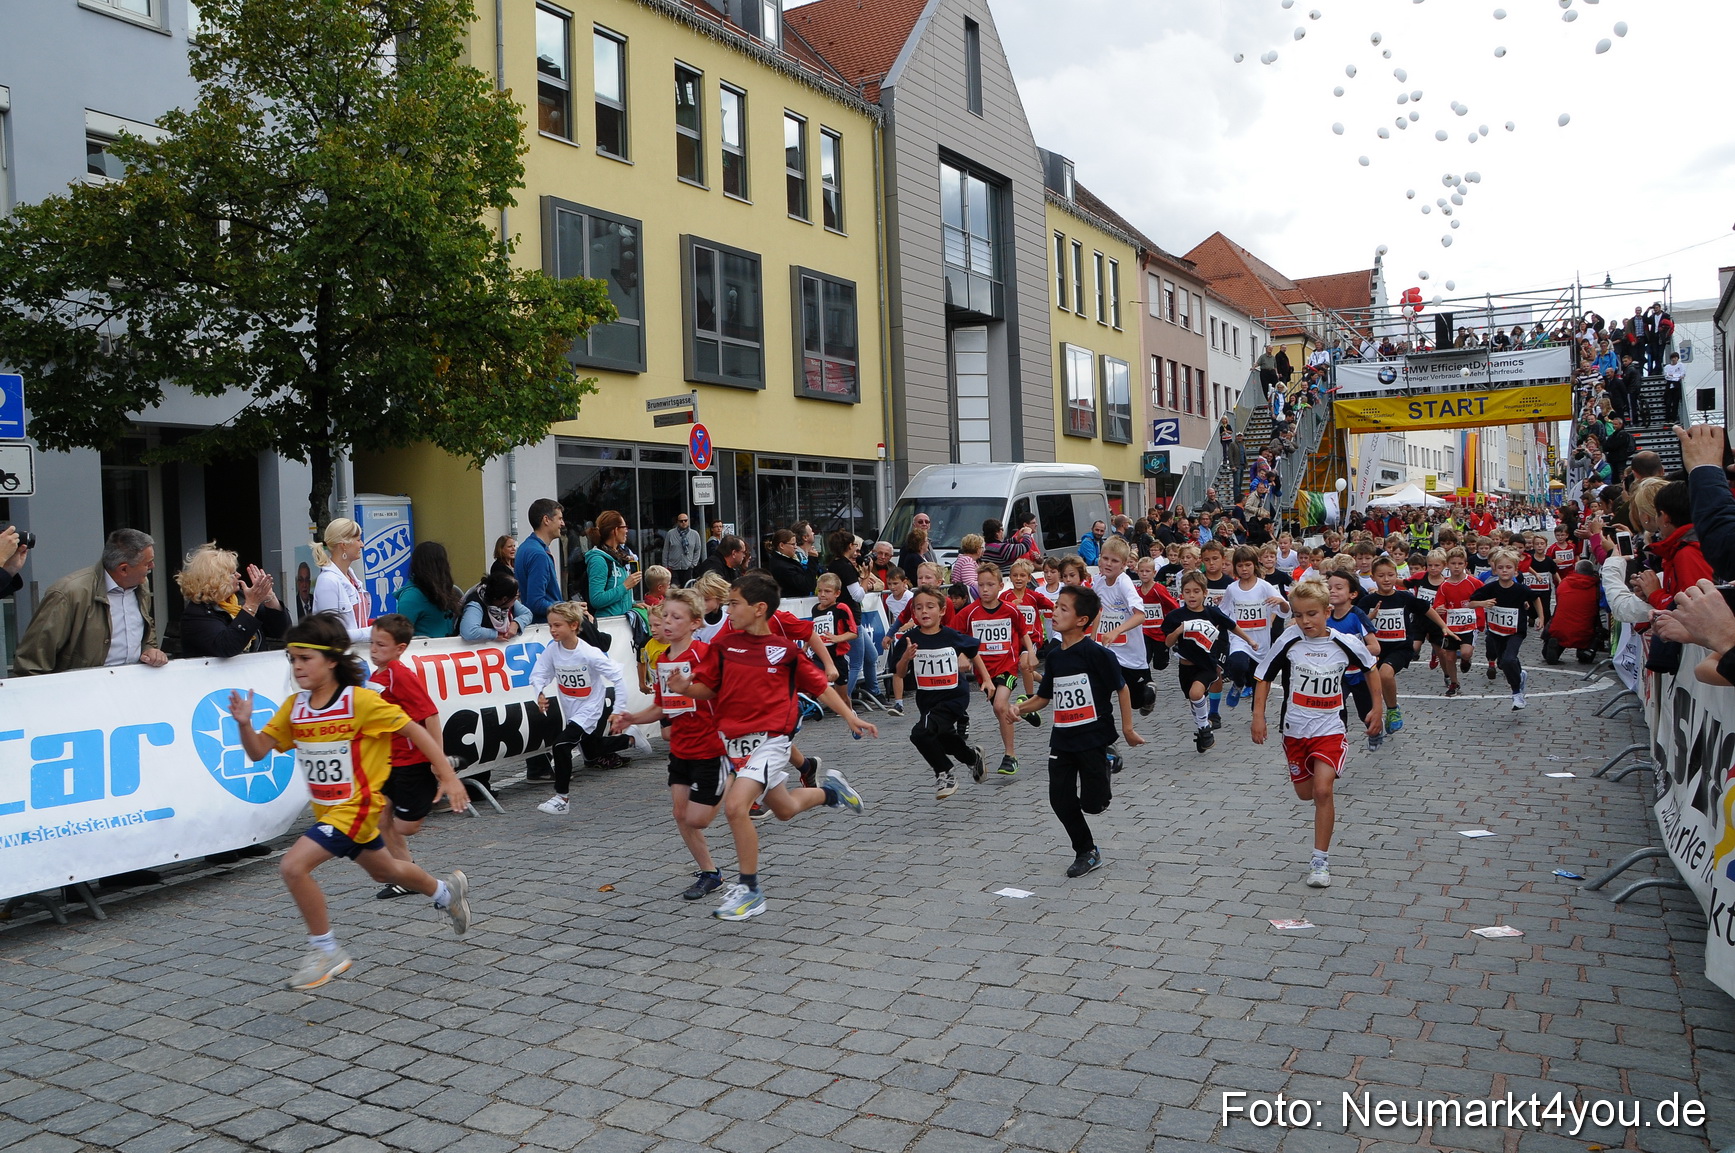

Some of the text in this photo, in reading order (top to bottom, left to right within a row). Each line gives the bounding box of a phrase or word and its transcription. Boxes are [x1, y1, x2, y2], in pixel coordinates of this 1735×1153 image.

[1402, 358, 1525, 375] BMW EfficientDynamics
[647, 397, 691, 410] Brunnwirtsgasse
[1408, 396, 1489, 419] START
[1360, 477, 1368, 499] Audi
[1238, 608, 1262, 620] 7391
[1450, 615, 1473, 625] 7228
[1489, 611, 1514, 627] 7113
[1374, 617, 1401, 630] 7205
[977, 627, 1008, 642] 7099
[918, 657, 953, 675] 7111
[1295, 666, 1313, 675] PARTL
[1300, 674, 1339, 694] 7108
[1306, 698, 1334, 707] Fabian
[320, 723, 355, 737] BÖGL
[299, 759, 343, 783] 283
